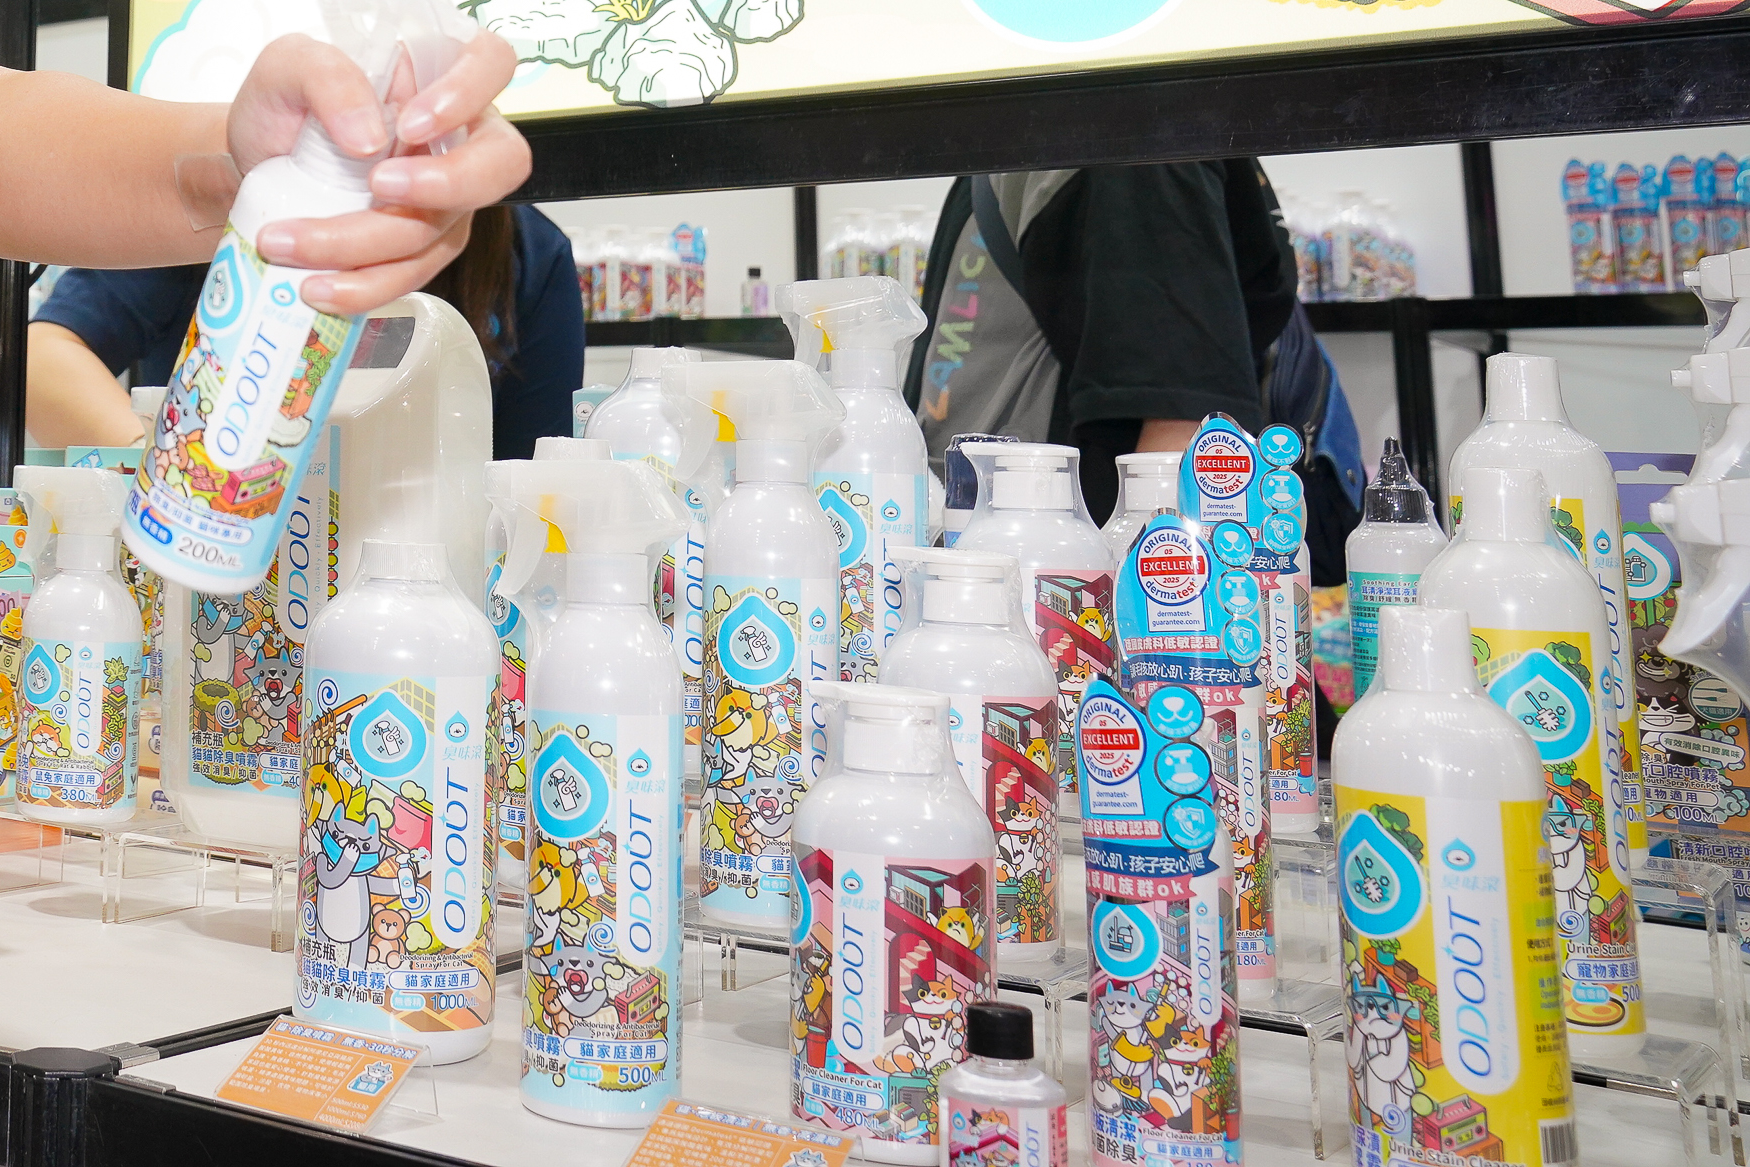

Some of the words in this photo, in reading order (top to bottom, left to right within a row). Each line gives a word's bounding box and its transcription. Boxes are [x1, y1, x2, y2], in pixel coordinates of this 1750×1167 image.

[216, 321, 279, 457] ODOUT
[1199, 434, 1241, 453] ORIGINAL
[1197, 459, 1248, 469] EXCELLENT
[178, 536, 242, 567] 200ML
[1143, 532, 1193, 554] ORIGINAL
[1143, 561, 1201, 572] EXCELLENT
[1162, 576, 1180, 584] 2025
[1152, 618, 1200, 627] guarantee.com
[1157, 610, 1193, 618] dermatest-
[1276, 613, 1288, 680] ODOUT
[77, 670, 92, 749] ODOUT
[1083, 701, 1126, 725] ORIGINAL
[191, 731, 224, 749] 補充瓶
[1083, 733, 1136, 746] EXCELLENT
[1663, 737, 1741, 759] 有效消除口腔異味
[191, 746, 258, 768] 貓貓除臭噴霧
[1099, 751, 1115, 760] 2025
[34, 770, 96, 786] 鼠兔家庭適用
[1665, 779, 1690, 789] Spray
[1704, 782, 1720, 791] Pet
[60, 788, 102, 803] 380ML
[1096, 791, 1129, 799] dermatest-
[1242, 751, 1255, 827] ODOUT
[1602, 716, 1628, 874] ODOUT
[1092, 799, 1138, 809] guarantee.com
[1672, 805, 1725, 825] 100ML
[444, 767, 468, 933] ODOUT
[1701, 856, 1729, 865] Mouth
[629, 798, 652, 953] ODOUT
[1566, 941, 1600, 956] Urine
[1601, 943, 1625, 956] Stain
[301, 957, 386, 990] 貓貓除臭噴霧
[415, 960, 438, 969] Spray
[1198, 928, 1212, 1015] ODOUT
[404, 973, 471, 988] 貓家庭適用
[841, 912, 865, 1051] ODOUT
[1448, 895, 1492, 1077] ODOUT
[430, 993, 479, 1010] 1000ML
[573, 1019, 614, 1031] Deodorizing
[590, 1029, 613, 1039] Spray
[580, 1044, 657, 1060] 貓家庭適用
[618, 1066, 668, 1085] 500ML
[802, 1063, 818, 1078] Floor
[818, 1069, 849, 1085] Cleaner
[850, 1076, 866, 1088] For
[866, 1079, 882, 1091] Cat
[811, 1081, 867, 1108] 貓家庭適用
[834, 1107, 883, 1131] 480ML
[1165, 1131, 1197, 1140] Cleaner
[1388, 1140, 1423, 1159] Urine
